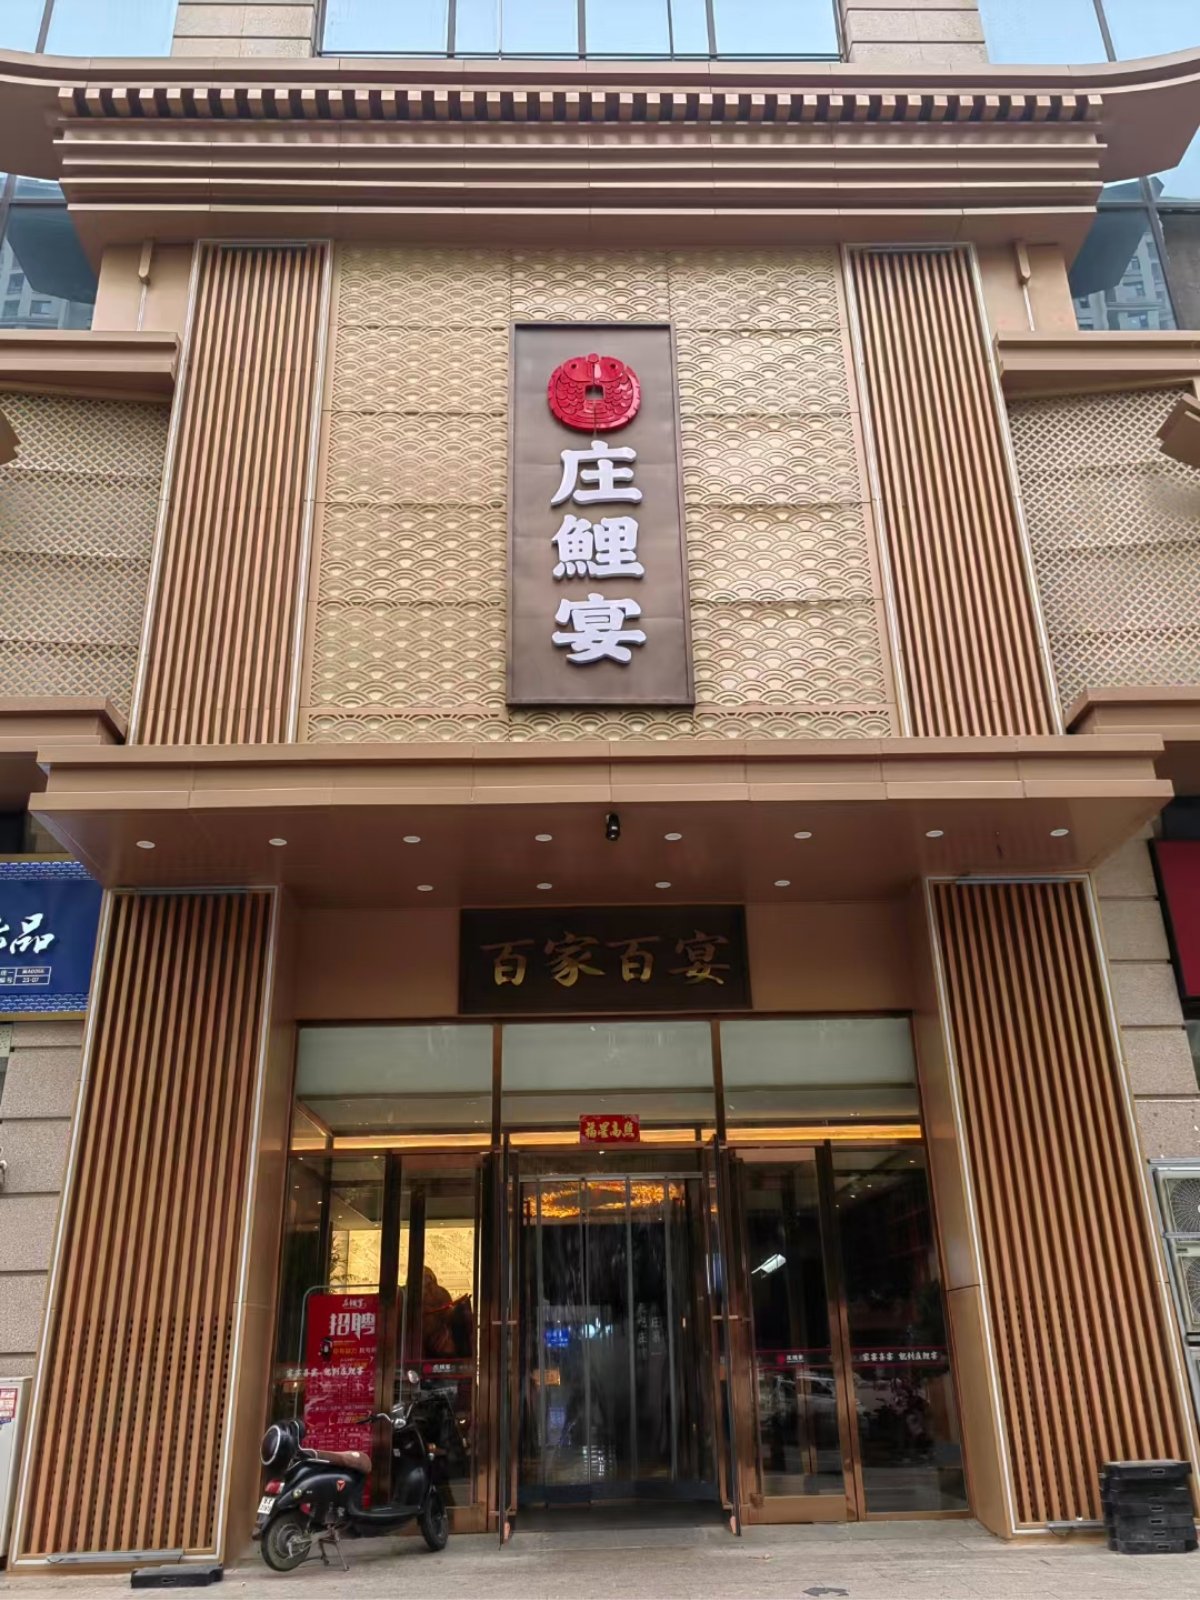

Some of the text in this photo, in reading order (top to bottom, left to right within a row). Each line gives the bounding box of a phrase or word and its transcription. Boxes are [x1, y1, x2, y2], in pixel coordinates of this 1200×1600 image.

[480, 930, 731, 987] 百家百宴
[329, 1312, 376, 1341] 招聘
